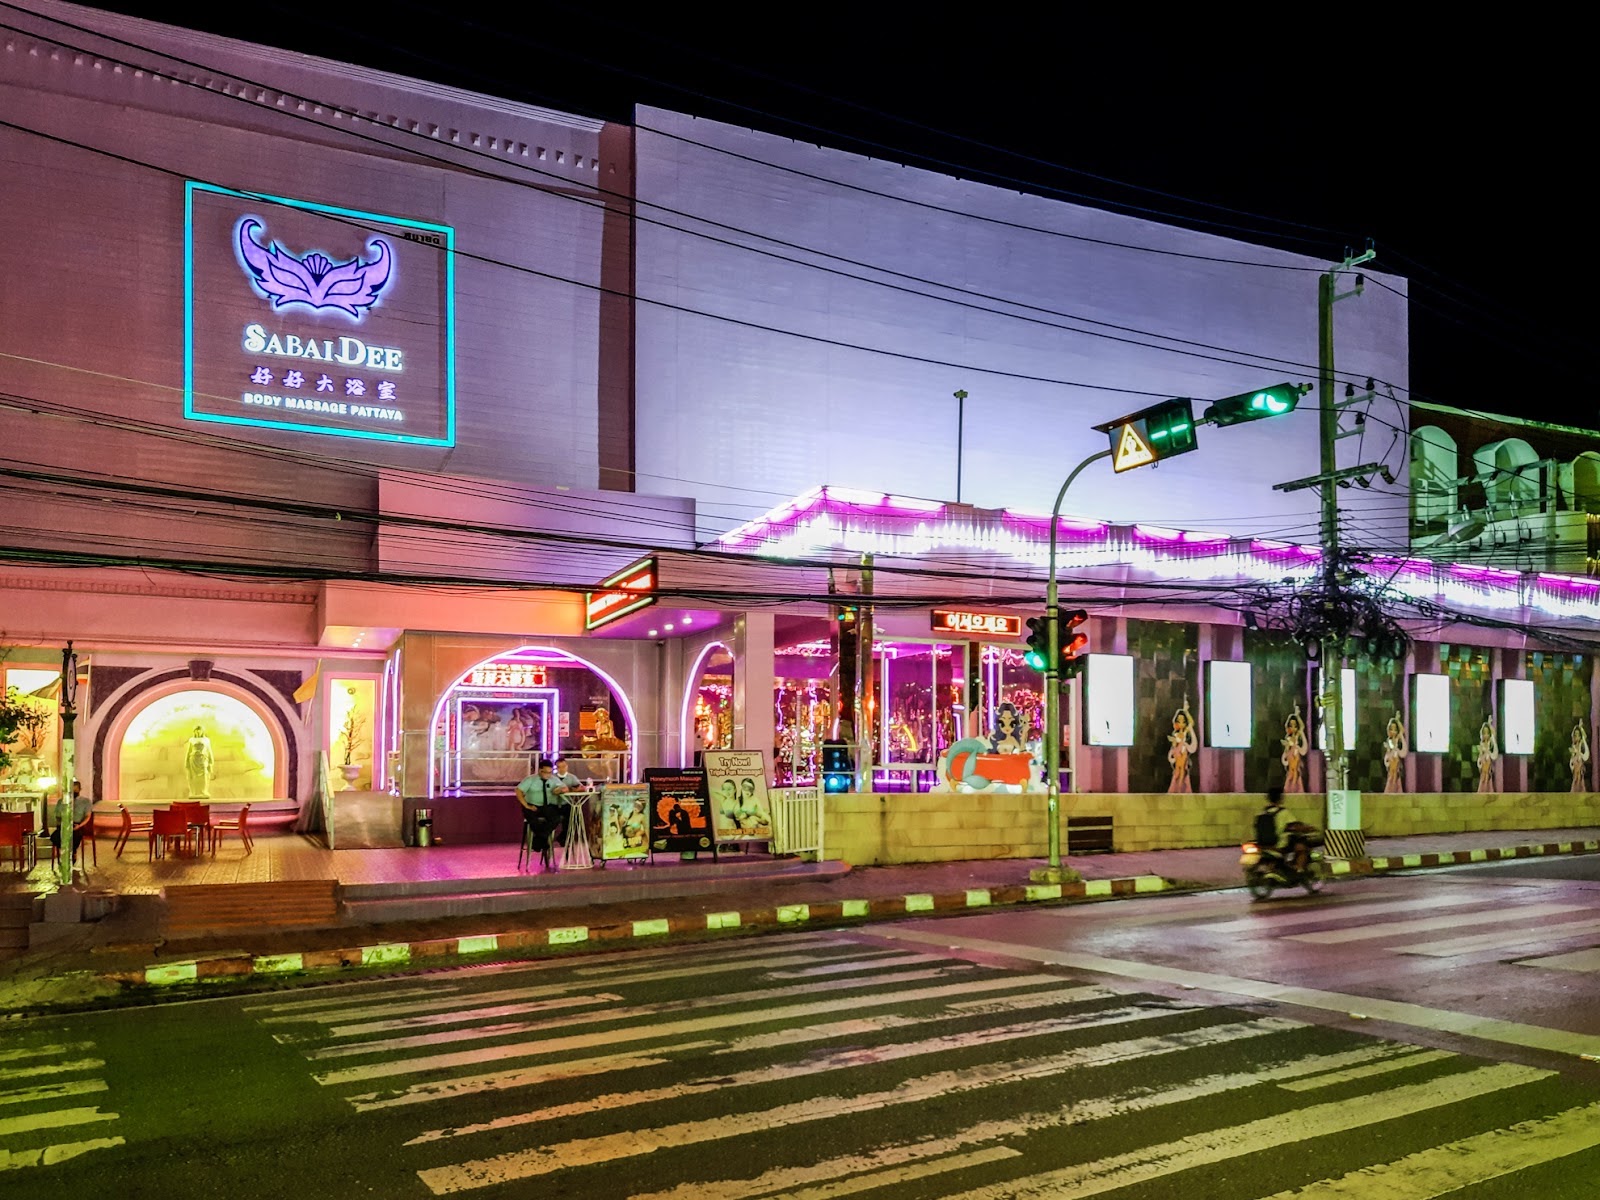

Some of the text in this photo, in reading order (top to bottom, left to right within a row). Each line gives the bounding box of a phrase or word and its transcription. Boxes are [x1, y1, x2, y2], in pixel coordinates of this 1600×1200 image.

[250, 366, 397, 401] 好好大浴室
[244, 392, 403, 421] BODY MASSAGE PATTAYA
[719, 757, 751, 768] Try Now!
